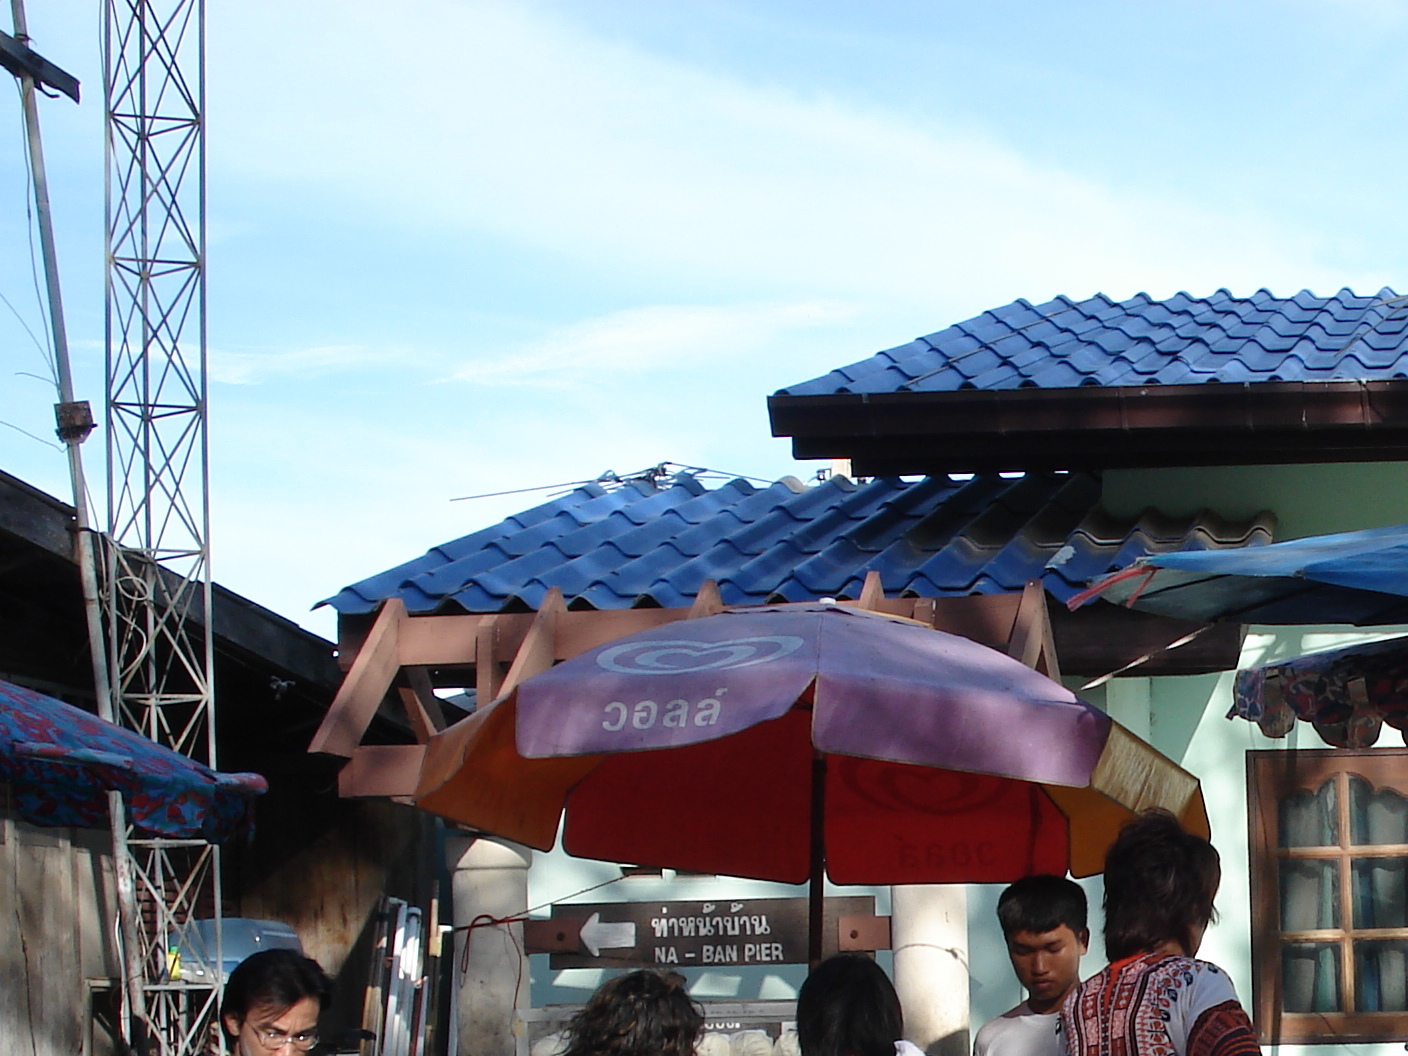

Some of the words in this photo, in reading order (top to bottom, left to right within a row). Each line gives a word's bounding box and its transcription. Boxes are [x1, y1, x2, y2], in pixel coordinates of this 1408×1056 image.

[602, 687, 728, 731] วอลล์
[651, 902, 771, 938] ท่าหน้าบ้าน
[654, 945, 678, 964] NA
[702, 944, 738, 963] BAN
[744, 942, 784, 962] PIER
